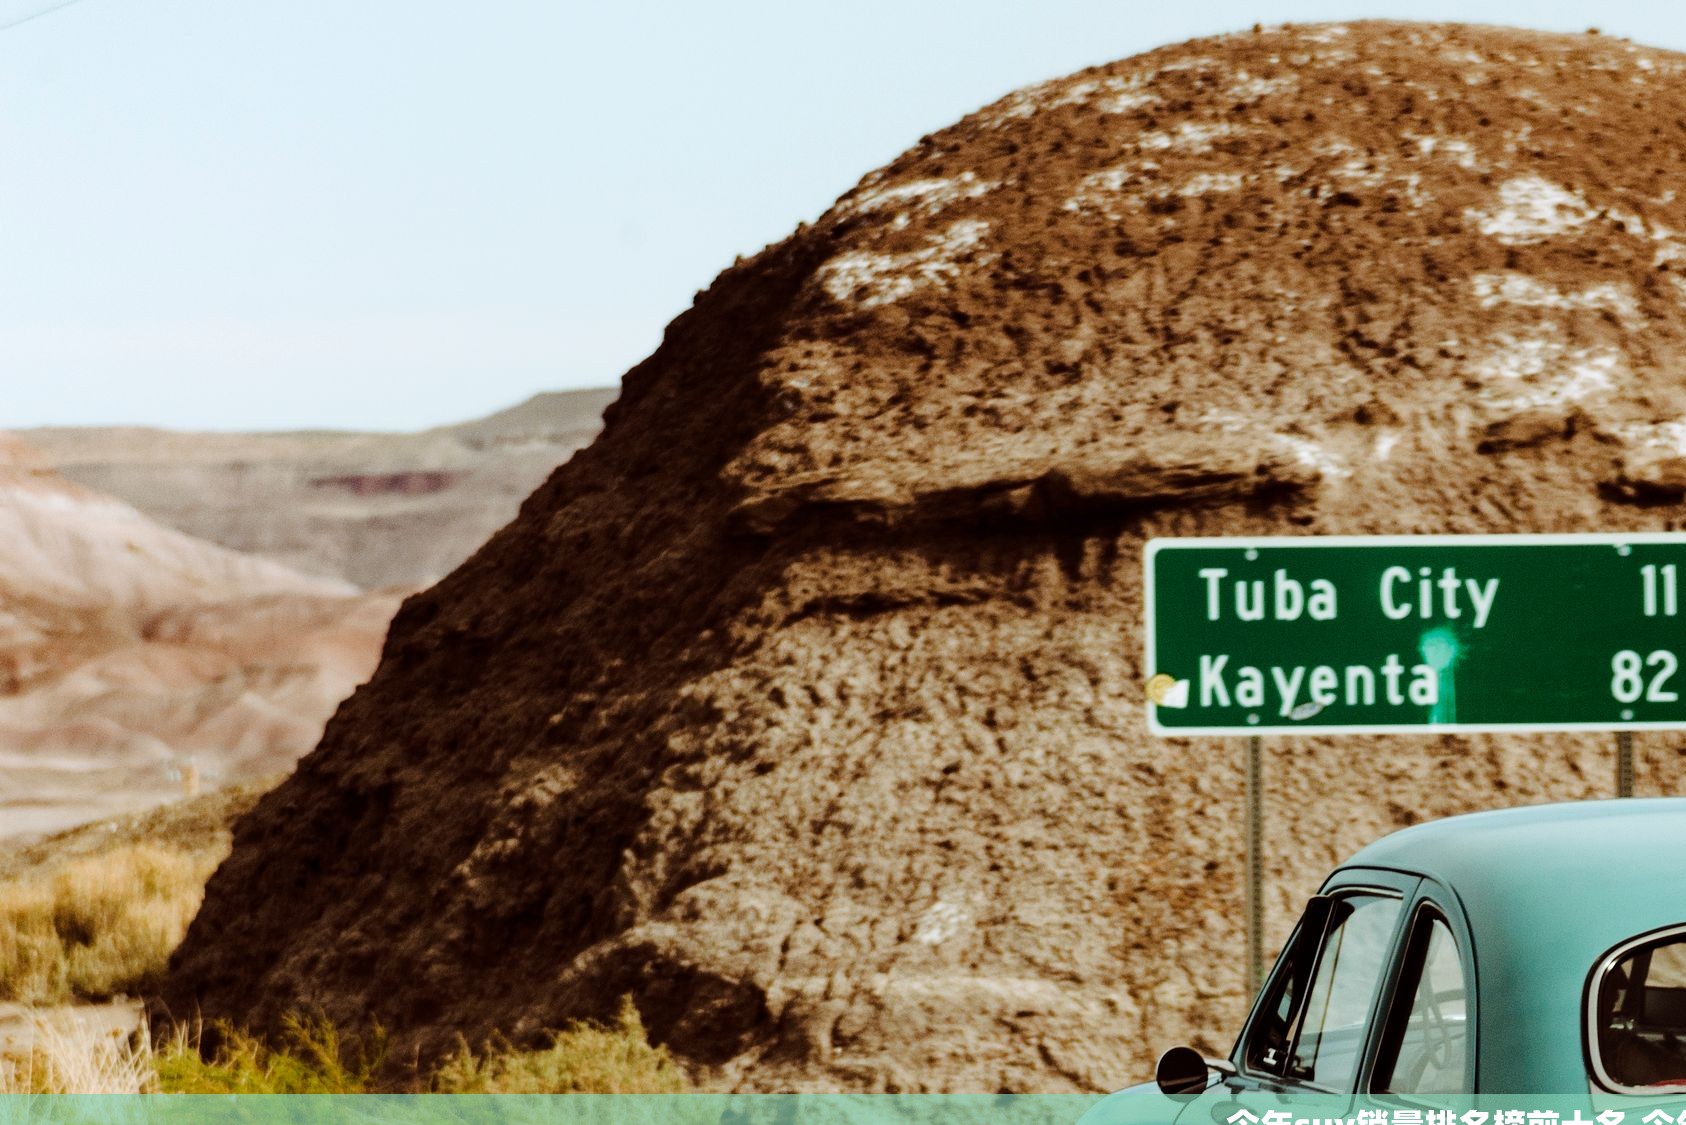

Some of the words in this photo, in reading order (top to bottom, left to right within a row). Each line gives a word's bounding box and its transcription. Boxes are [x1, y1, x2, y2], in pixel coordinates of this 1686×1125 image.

[1199, 567, 1338, 621] Tuba
[1379, 565, 1500, 629] City
[1640, 563, 1678, 617] 11
[1200, 654, 1440, 717] Kayenta
[1610, 649, 1679, 702] 82
